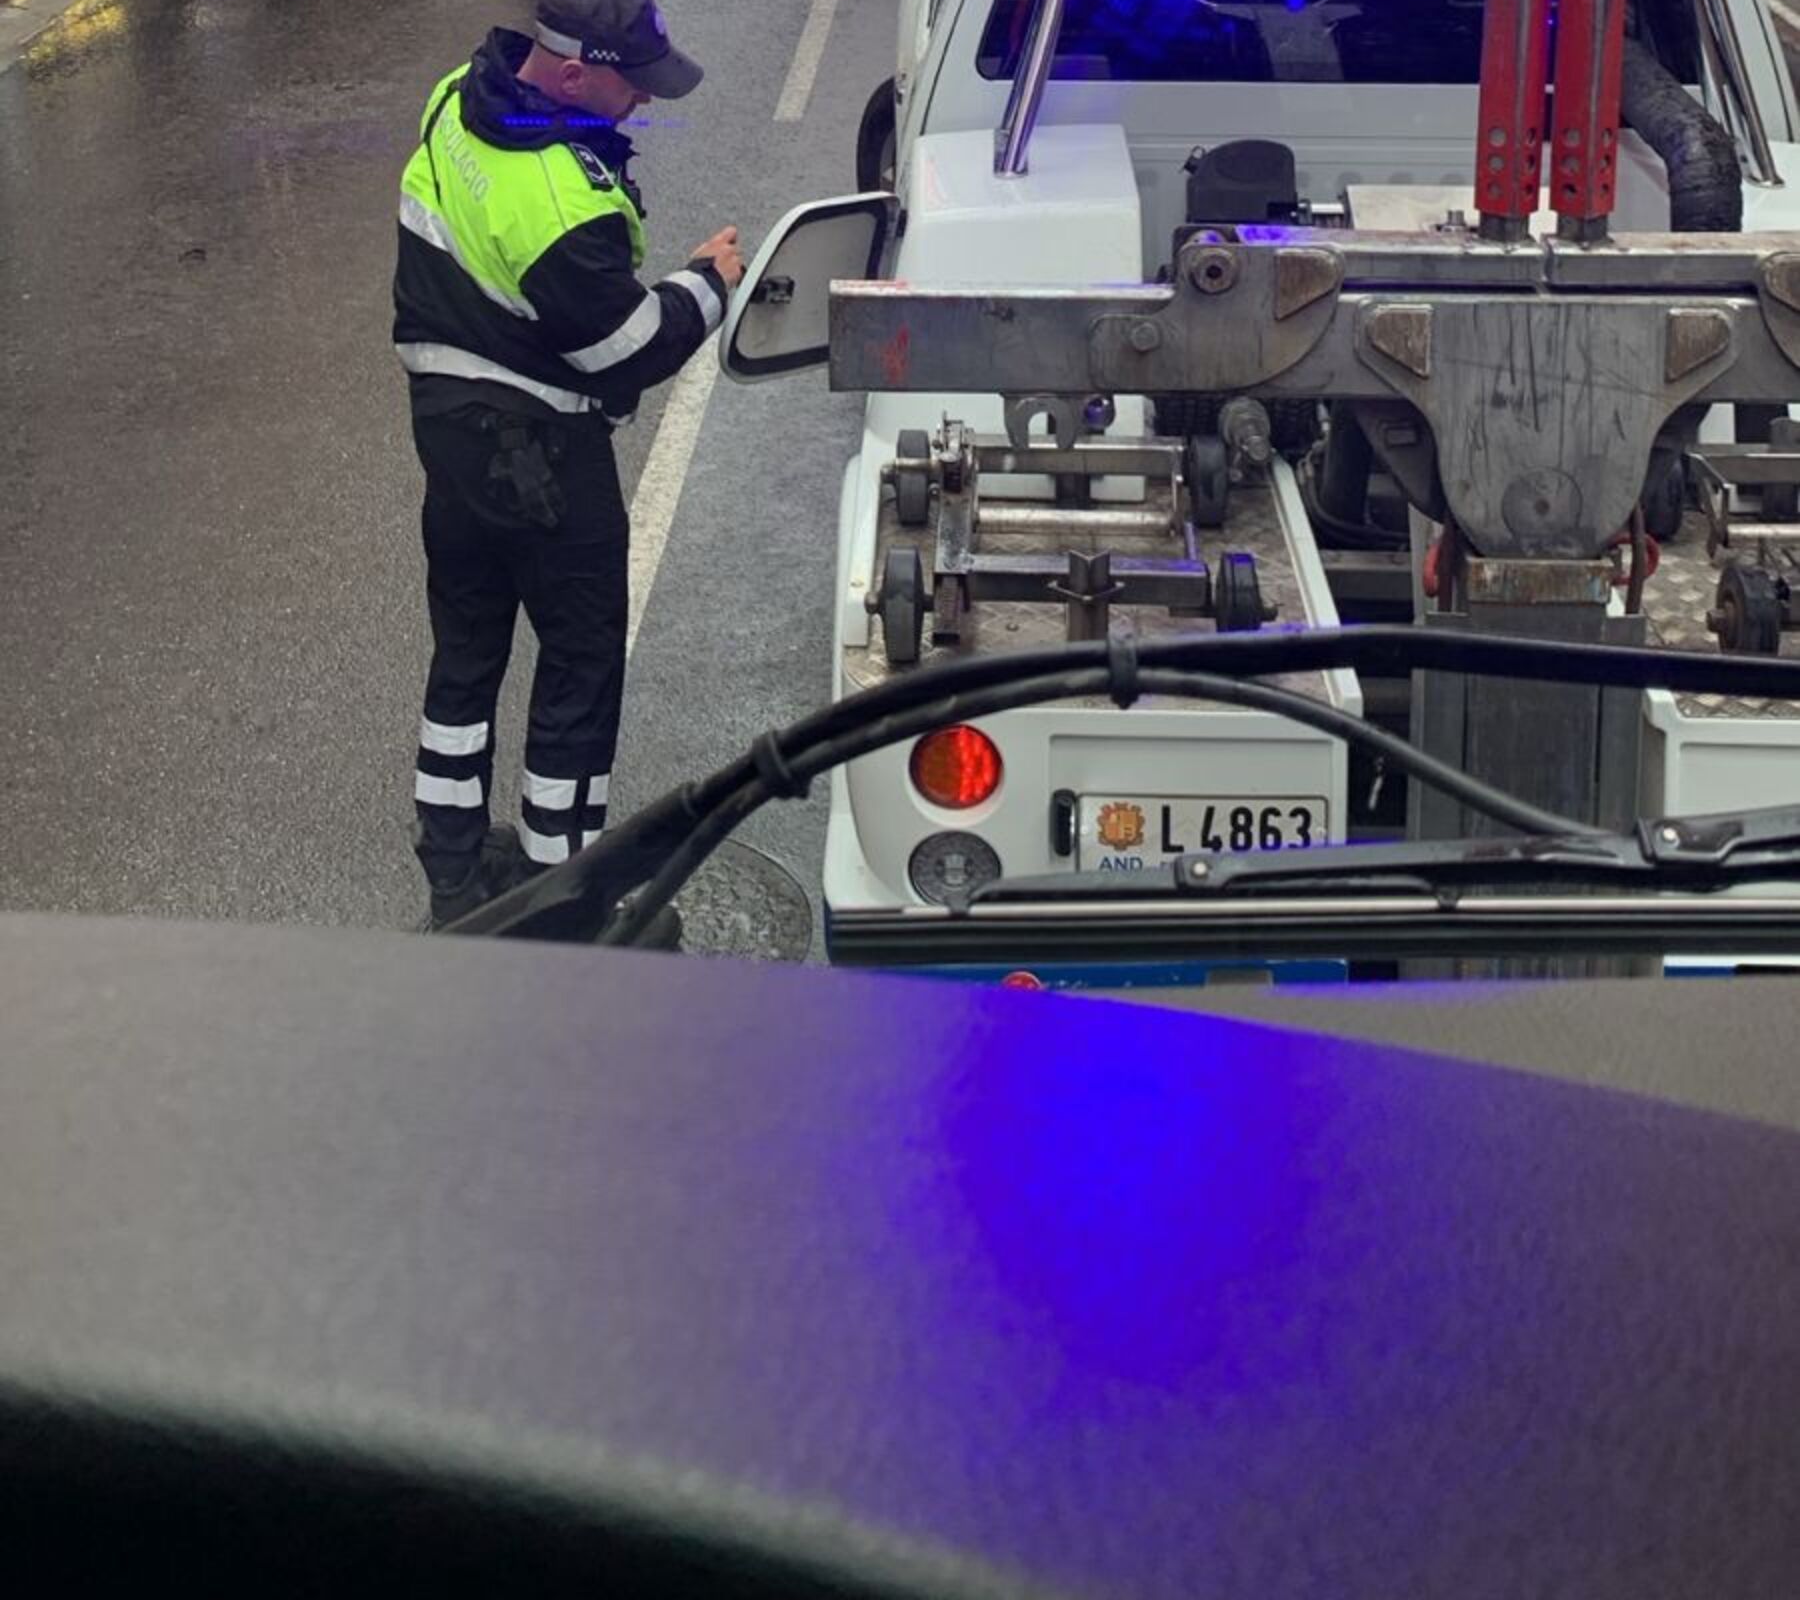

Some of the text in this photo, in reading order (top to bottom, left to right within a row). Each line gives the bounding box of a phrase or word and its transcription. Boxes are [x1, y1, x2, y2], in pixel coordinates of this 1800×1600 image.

[1161, 804, 1312, 853] L 4863
[1099, 856, 1144, 872] AND
